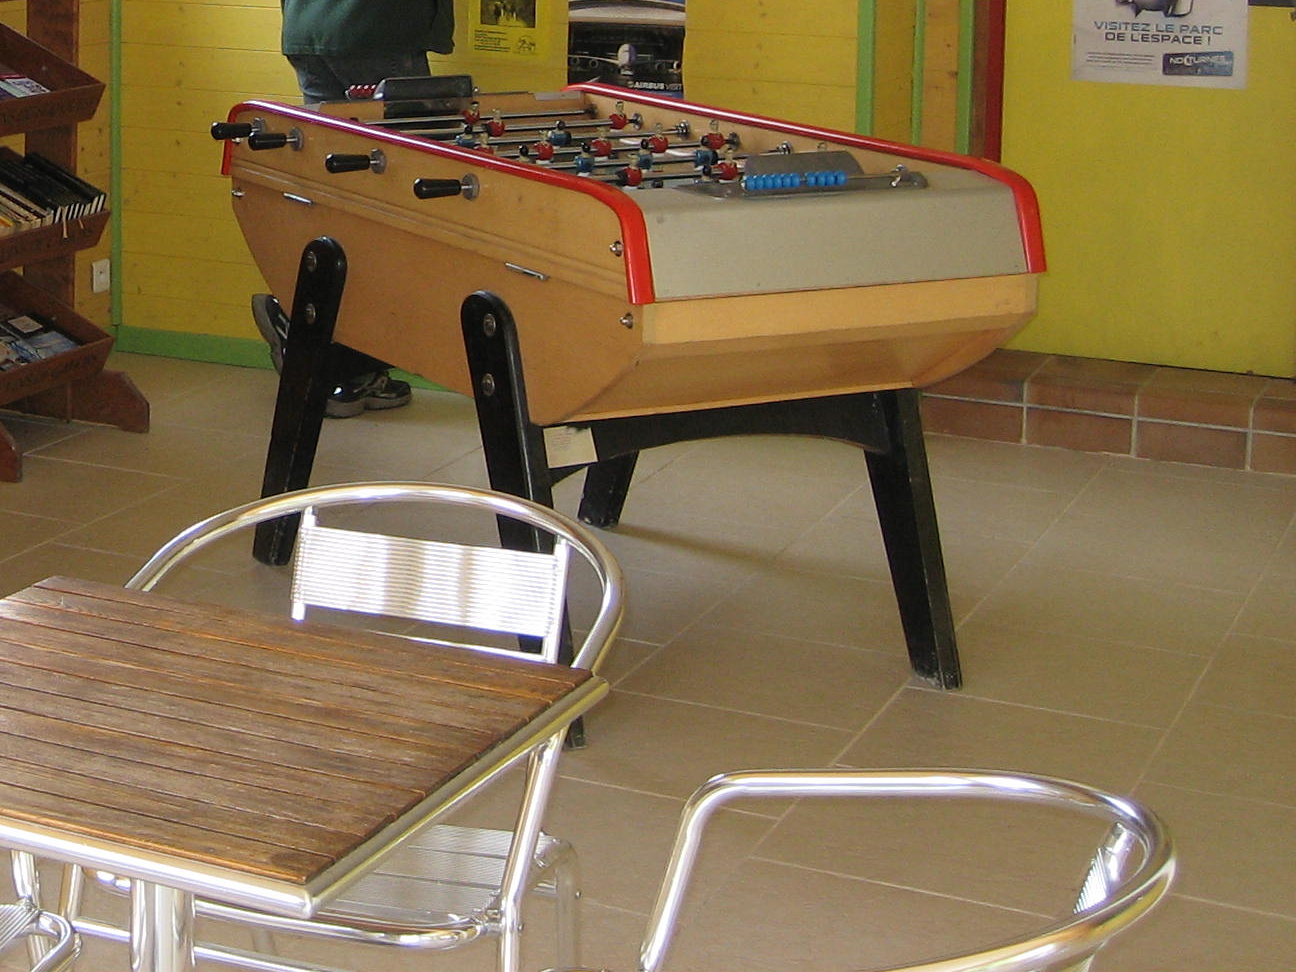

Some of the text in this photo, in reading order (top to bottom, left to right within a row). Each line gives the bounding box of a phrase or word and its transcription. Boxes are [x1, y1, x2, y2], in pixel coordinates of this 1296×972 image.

[1094, 21, 1223, 36] VISITEZ LE PARC
[1105, 31, 1125, 41] DE
[634, 81, 665, 90] AIRBUS
